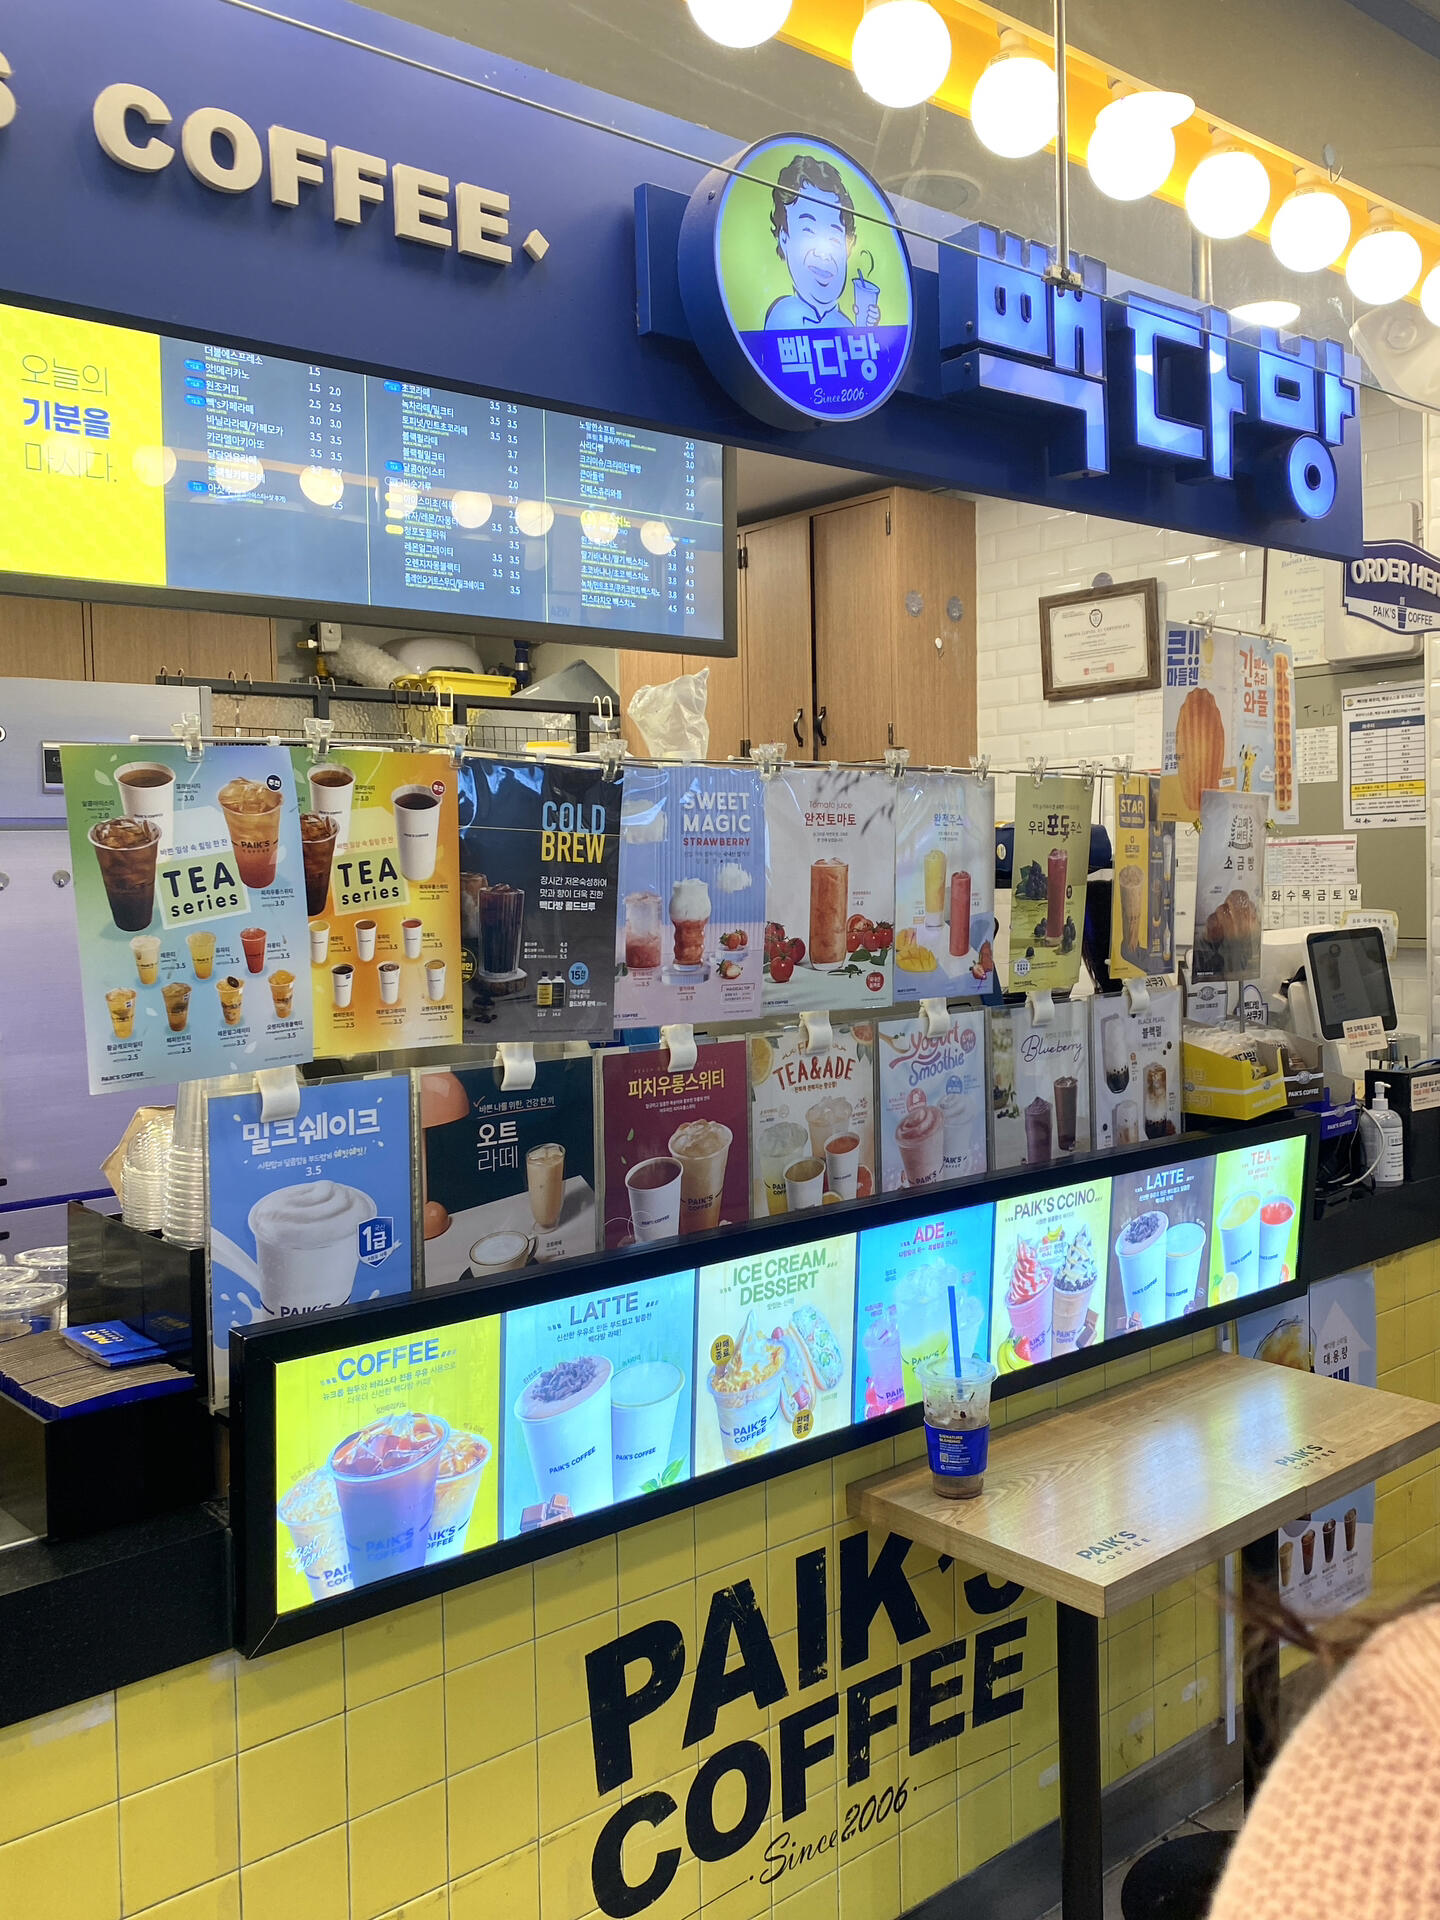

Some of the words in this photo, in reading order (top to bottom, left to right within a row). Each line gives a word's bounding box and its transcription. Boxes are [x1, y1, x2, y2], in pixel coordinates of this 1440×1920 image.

[777, 333, 880, 384] 빽다방
[20, 351, 110, 397] 오늘의
[309, 366, 321, 377] 1.5
[969, 222, 1355, 522] 빽다방
[309, 383, 321, 393] 1.5
[329, 386, 341, 396] 2.0
[309, 399, 321, 409] 2.5
[329, 402, 342, 413] 2.5
[490, 401, 500, 410] 3.5
[507, 404, 518, 414] 3.5
[22, 398, 112, 440] 기분을
[309, 416, 322, 426] 3.0
[329, 419, 342, 429] 3.0
[490, 416, 500, 425] 3.5
[507, 420, 518, 429] 3.5
[310, 432, 322, 442] 3.5
[330, 435, 342, 445] 3.5
[490, 432, 500, 441] 3.5
[507, 435, 518, 444] 3.5
[685, 442, 695, 451] 2.0
[310, 448, 323, 459] 3.5
[330, 452, 343, 462] 3.5
[507, 450, 518, 459] 3.7
[508, 465, 518, 474] 4.2
[685, 461, 695, 470] 3.0
[508, 480, 519, 489] 2.0
[492, 523, 502, 532] 3.5
[509, 526, 519, 534] 3.5
[509, 541, 520, 550] 3.5
[492, 553, 502, 562] 3.5
[509, 556, 520, 565] 3.5
[493, 569, 503, 578] 3.5
[510, 571, 520, 580] 3.5
[1351, 558, 1410, 585] ORDER
[510, 586, 521, 595] 3.5
[1372, 606, 1396, 619] PAIK'S
[1407, 611, 1433, 626] COFFEE
[1167, 667, 1198, 687] 마들렌
[1243, 690, 1269, 717] 와플
[683, 791, 750, 811] SWEET
[1120, 800, 1144, 815] STAR
[541, 800, 606, 834] COLD
[683, 814, 751, 832] MAGIC
[804, 812, 857, 827] 완전토마토
[541, 831, 606, 864] BREW
[683, 837, 750, 847] STRAWBERRY
[162, 861, 236, 898] TEA
[337, 857, 398, 887] TEA
[540, 876, 563, 886] 장시간
[564, 876, 607, 887] 저온숙성하여
[341, 886, 399, 905] series
[540, 889, 556, 898] 맛과
[556, 889, 572, 898] 향이
[573, 889, 588, 899] 더욱
[589, 890, 604, 899] 진한
[1271, 890, 1281, 902] 화
[1286, 890, 1296, 902] 수
[1301, 889, 1312, 902] 목
[1316, 889, 1327, 902] 금
[1332, 889, 1343, 901] 토
[1348, 888, 1358, 901] 일
[171, 894, 238, 917] series
[565, 901, 596, 911] 콜드브루
[1142, 1025, 1162, 1039] 블랙펄
[127, 1053, 139, 1061] 2.5
[1021, 1034, 1082, 1062] Blueberry
[121, 1071, 145, 1080] COFFEE
[772, 1056, 856, 1091] TEA&ADE
[909, 1050, 965, 1087] Smoothie
[628, 1068, 725, 1099] 피치우롱스위티
[243, 1108, 381, 1156] 밀크쉐이크
[477, 1120, 519, 1147] 오트
[478, 1145, 519, 1172] 라떼
[1251, 1149, 1272, 1166] TEA
[305, 1165, 322, 1176] 3.5
[1146, 1168, 1185, 1191] LATTE
[1014, 1196, 1055, 1220] PAIK'S
[1057, 1188, 1095, 1210] CCINO
[913, 1221, 945, 1245] ADE
[733, 1262, 762, 1287] ICE
[765, 1247, 827, 1276] CREAM
[739, 1269, 819, 1306] DESSERT
[570, 1291, 638, 1326] LATTE
[557, 1331, 574, 1342] 신선한
[577, 1326, 594, 1336] 우유로
[338, 1338, 440, 1381] COFFEE
[733, 1416, 767, 1437] PAIK'S
[734, 1426, 767, 1444] COFFEE
[549, 1460, 571, 1475] PAIK'S
[571, 1446, 596, 1467] COFFEE
[616, 1453, 633, 1461] PAIK'S
[634, 1447, 657, 1460] COFFEE
[1274, 1443, 1323, 1468] PAIK'S
[1294, 1449, 1337, 1471] COFFEE
[366, 1527, 414, 1551] PAIK'S
[1076, 1529, 1137, 1560] PAIK'S
[1096, 1536, 1151, 1564] COFFEE
[592, 1617, 1028, 1919] COFFEE
